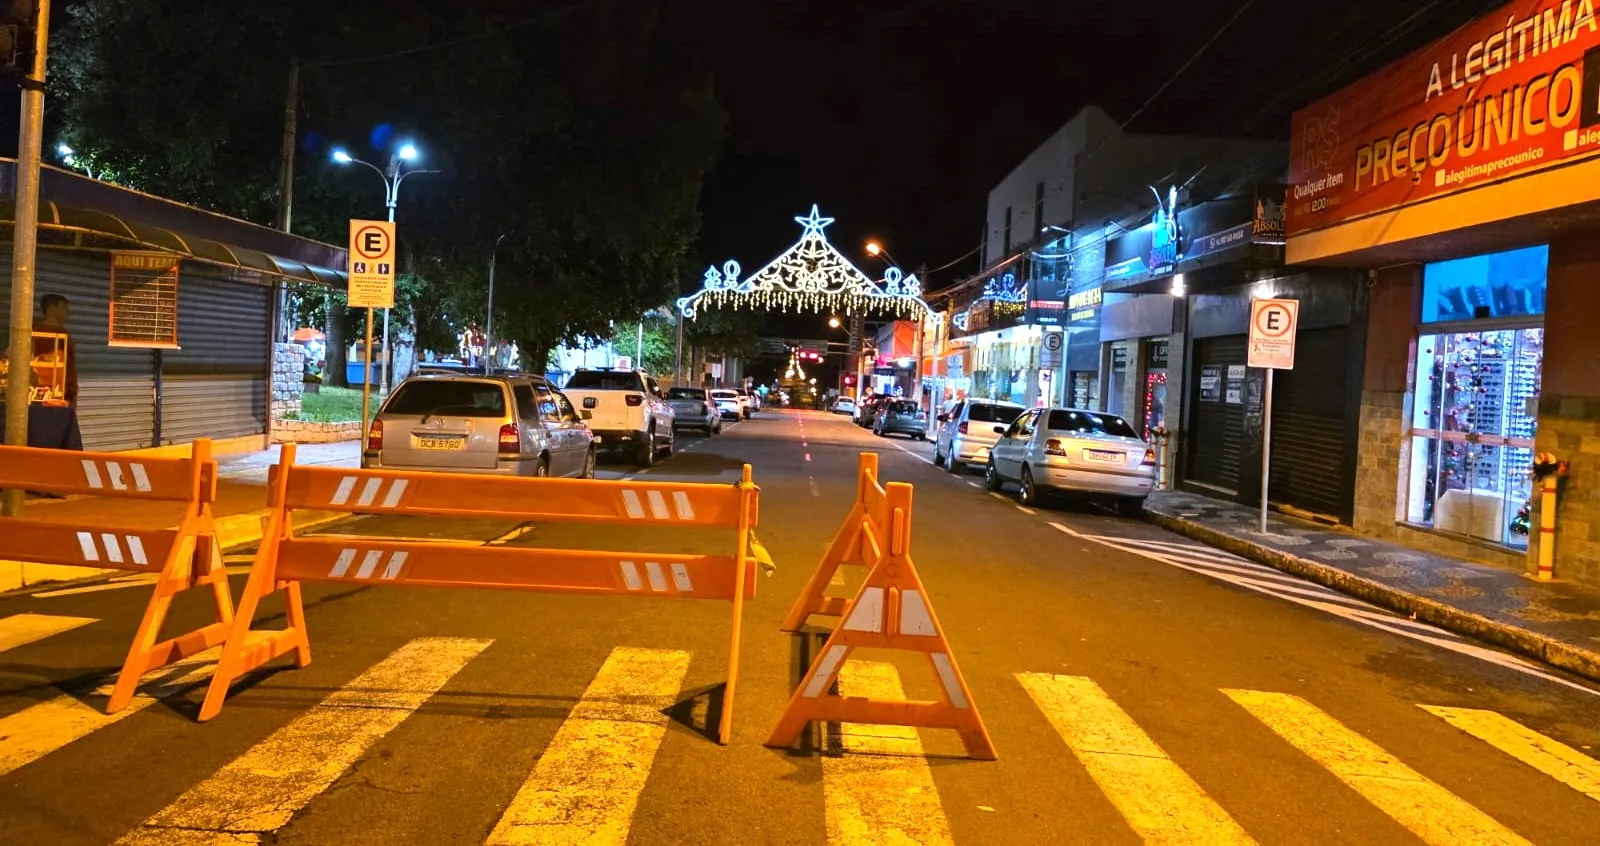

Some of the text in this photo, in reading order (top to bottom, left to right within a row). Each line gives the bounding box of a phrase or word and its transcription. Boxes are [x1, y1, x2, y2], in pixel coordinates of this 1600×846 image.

[1425, 0, 1597, 102] A LEGÍTIMA
[1354, 66, 1580, 191] PREÇO ÚNICO
[1445, 147, 1544, 186] alegitimaprecounico
[1294, 172, 1343, 200] Qualquer item
[364, 232, 381, 252] E
[114, 255, 144, 267] AQUI
[1267, 310, 1281, 330] E
[1049, 336, 1056, 348] E
